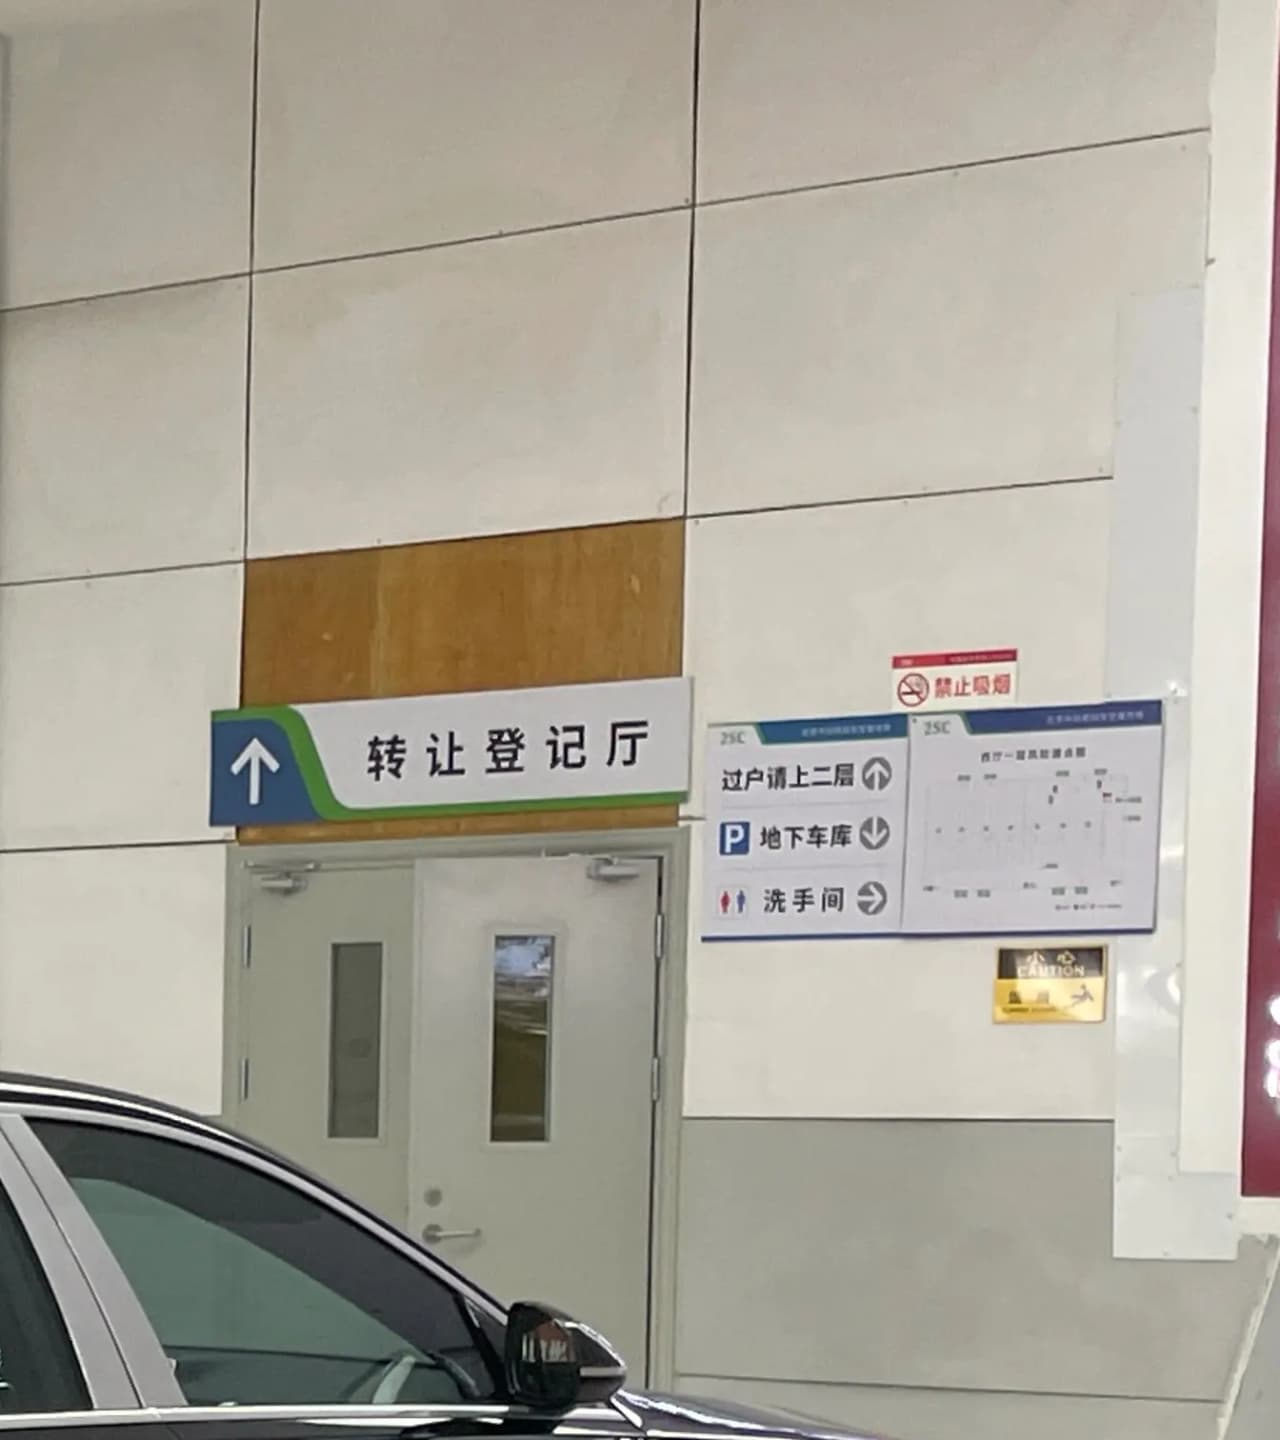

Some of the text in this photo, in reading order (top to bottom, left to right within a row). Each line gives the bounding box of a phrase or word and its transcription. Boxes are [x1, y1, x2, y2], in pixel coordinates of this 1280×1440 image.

[935, 674, 1011, 699] 禁止吸烟
[366, 719, 650, 781] 转让登记厅
[721, 763, 854, 792] 过户请上二层
[759, 823, 853, 851] 地下车库
[763, 886, 845, 914] 洗手间
[1017, 964, 1085, 977] CAUTION
